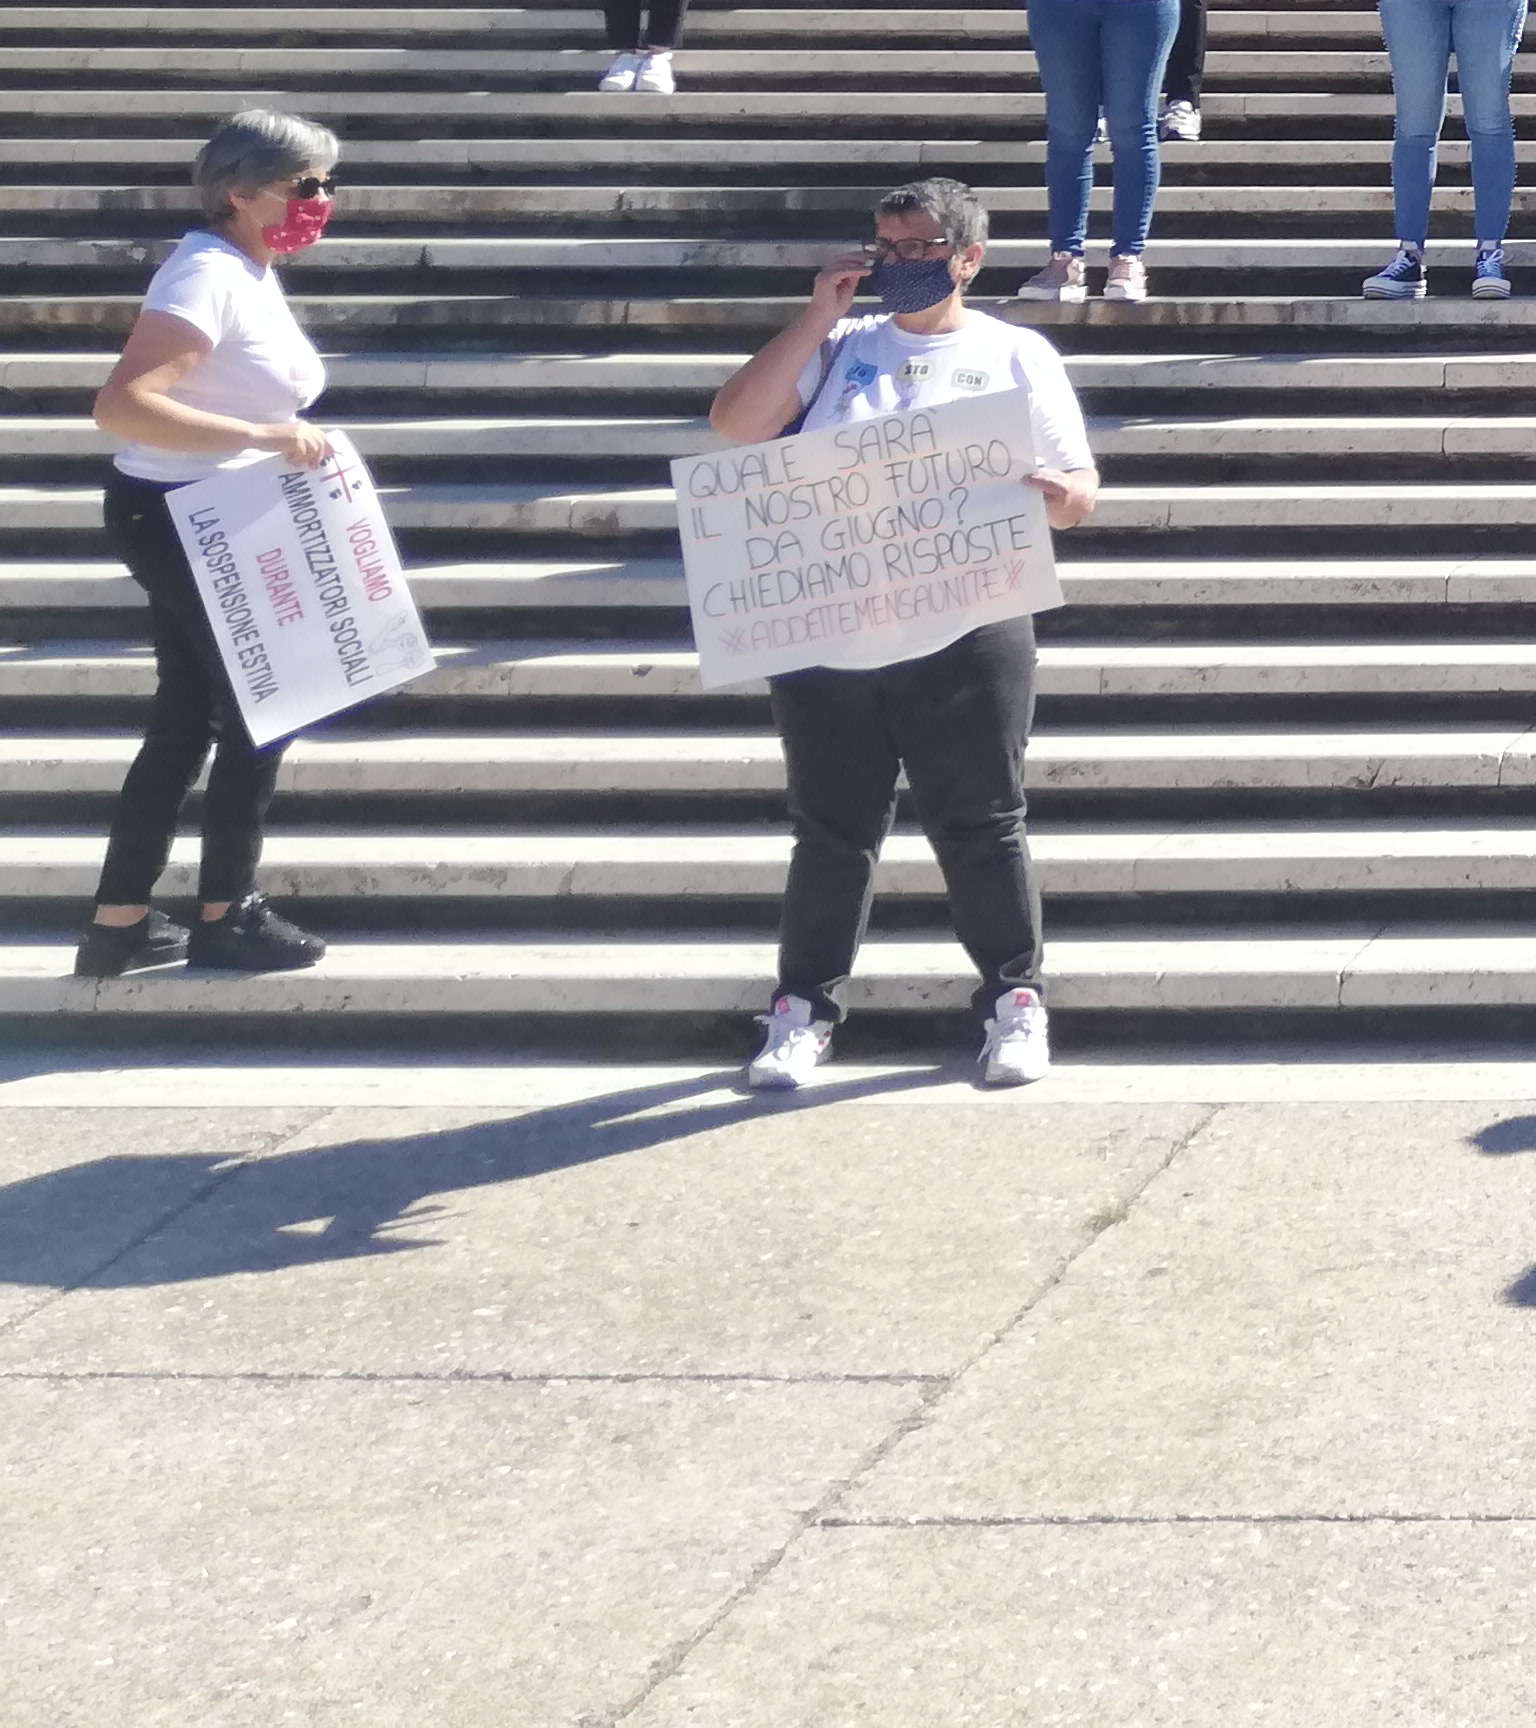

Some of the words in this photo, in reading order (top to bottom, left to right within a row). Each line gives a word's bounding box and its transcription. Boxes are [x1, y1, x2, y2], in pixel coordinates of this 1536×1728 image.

[689, 444, 805, 499] QUALE
[691, 506, 722, 540] IL
[744, 472, 869, 531] NOSTRO
[884, 439, 1012, 496] FUTURO
[188, 506, 217, 537] LA
[345, 517, 393, 603] VOGLIAMO
[746, 530, 804, 571] DA
[820, 486, 970, 553] GIUGNO?
[197, 527, 262, 647] SOSPENSIONE
[255, 547, 304, 627] DURANTE
[278, 470, 351, 621] AMMORTIZZATORI
[329, 614, 376, 688] SOCIALI
[703, 552, 871, 619] CHIEDIAMO
[882, 513, 1033, 583] RISPOSTE
[237, 639, 282, 704] ESTIVA
